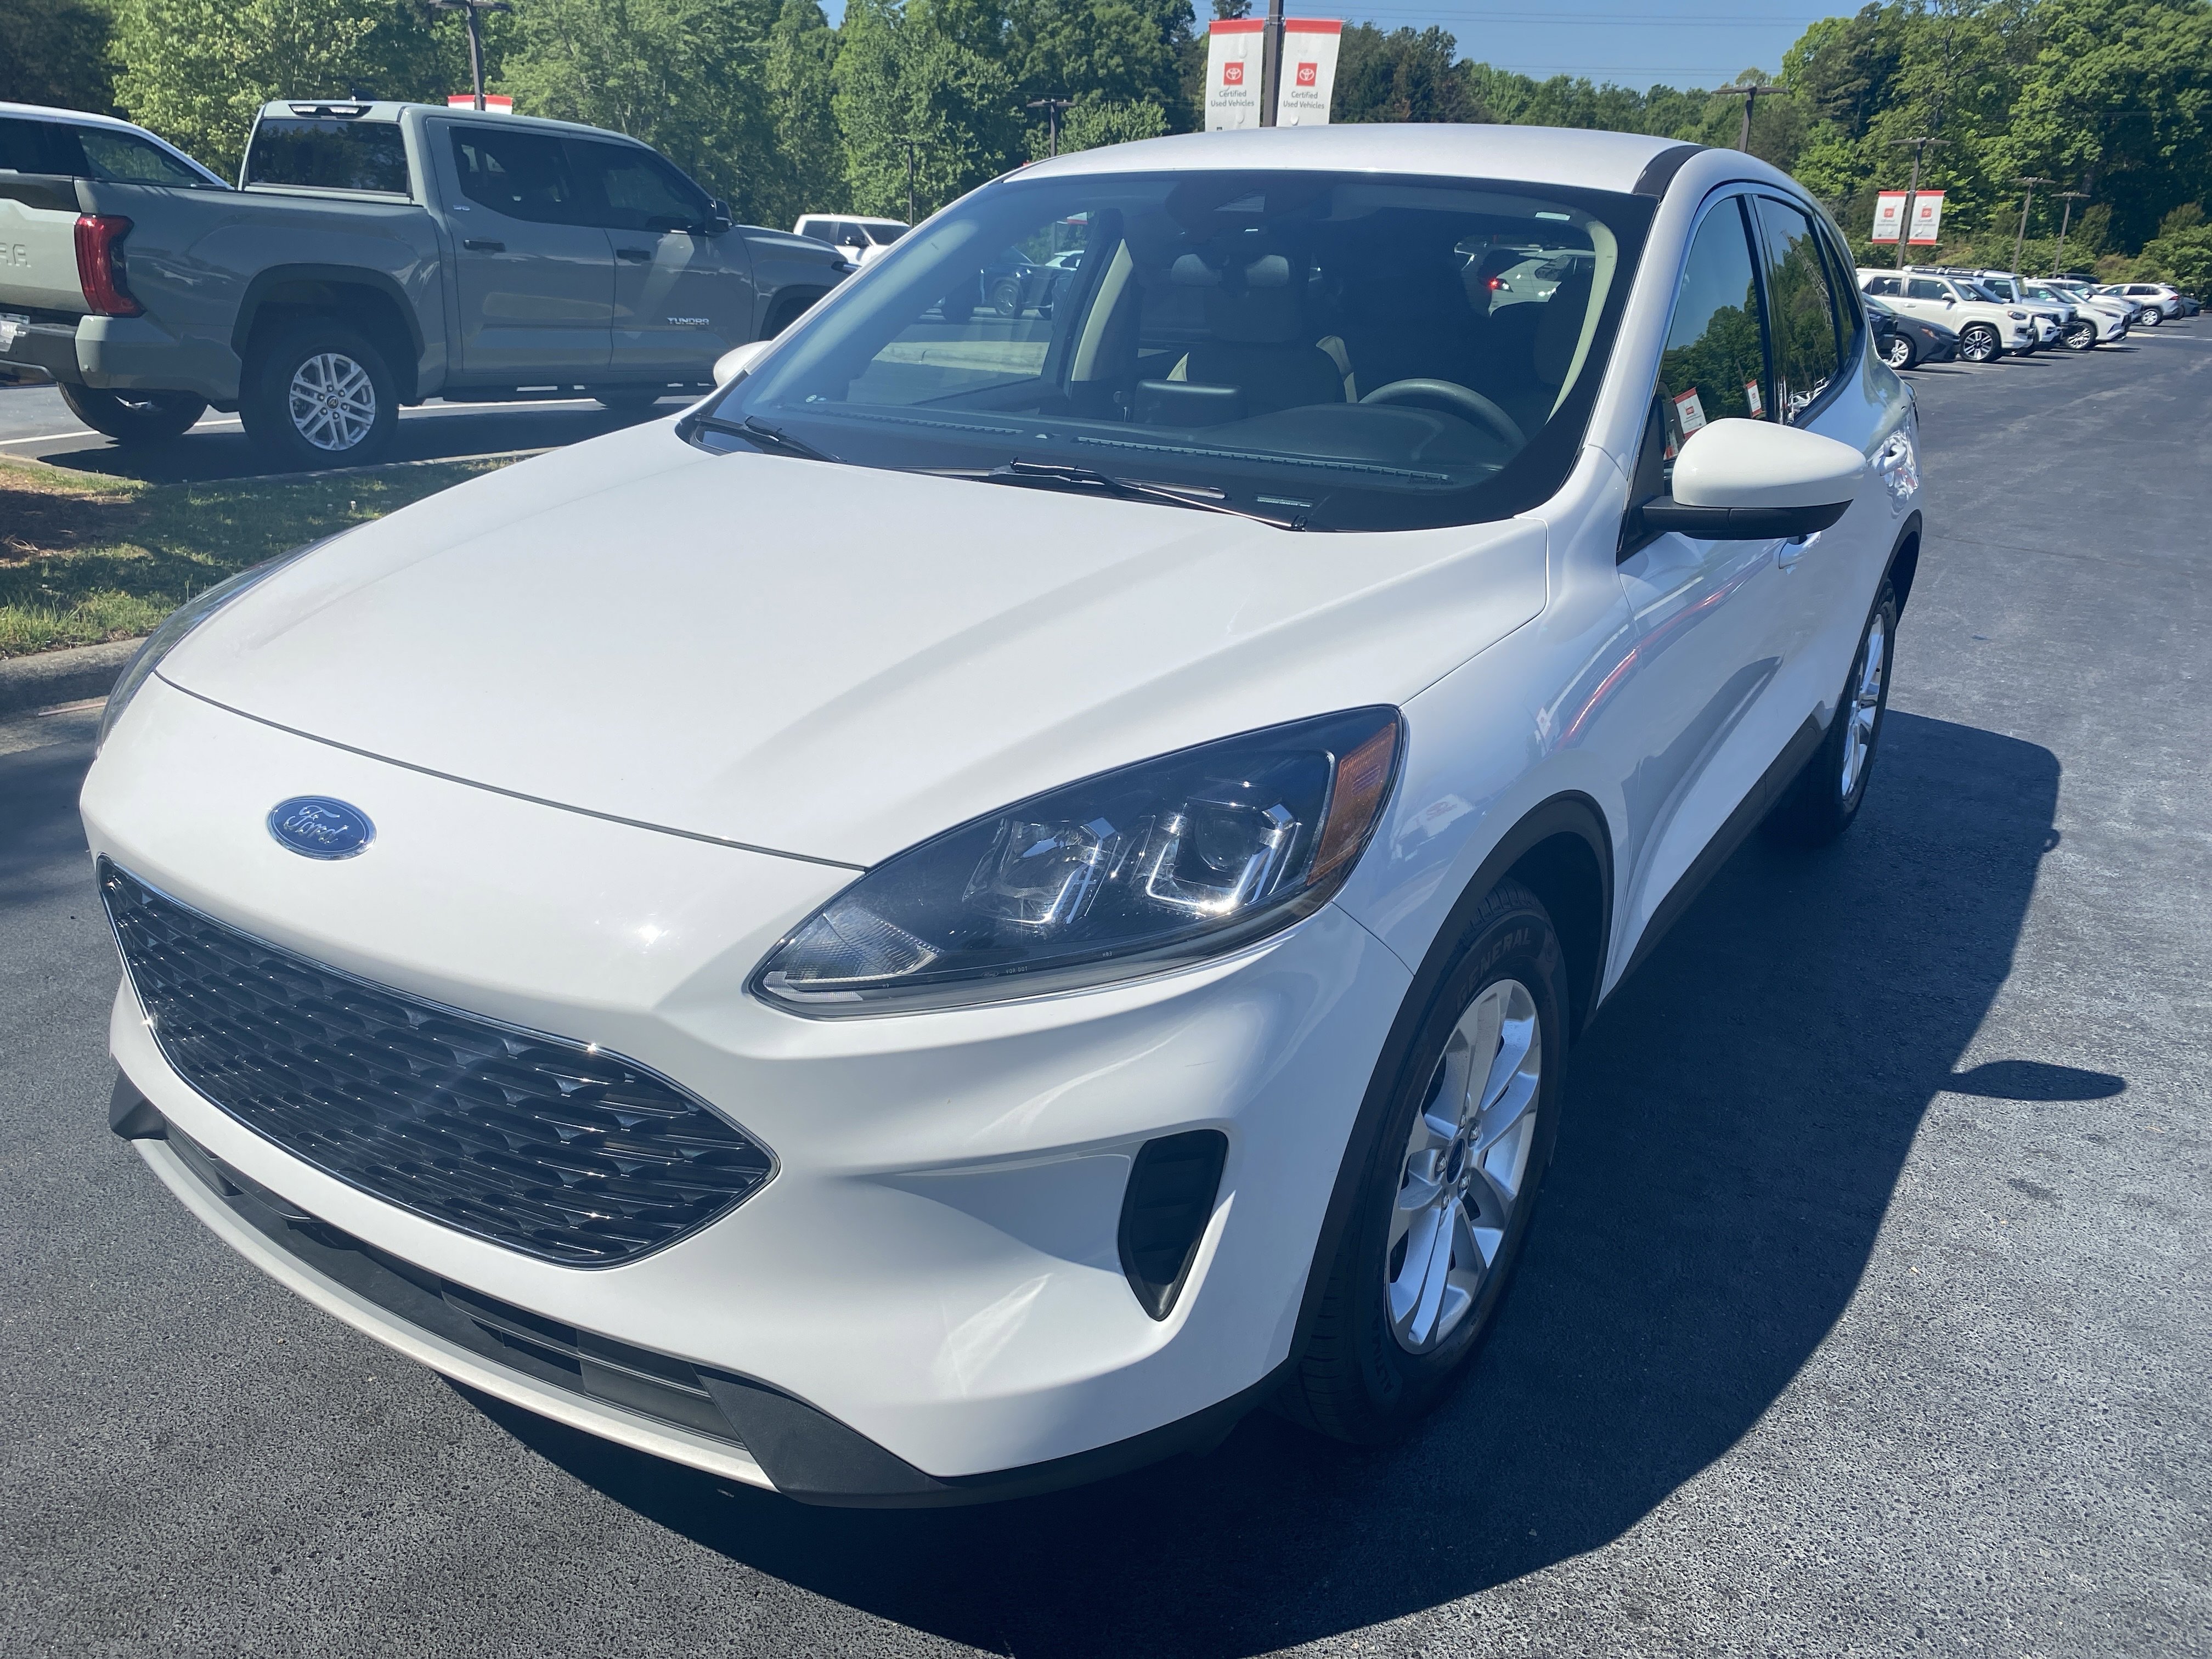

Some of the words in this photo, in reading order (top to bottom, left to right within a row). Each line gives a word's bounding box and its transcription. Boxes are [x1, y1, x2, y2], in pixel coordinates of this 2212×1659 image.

[1300, 101, 1324, 109] Vehicles
[283, 805, 349, 845] Ford
[1457, 927, 1531, 1013] GENERAL
